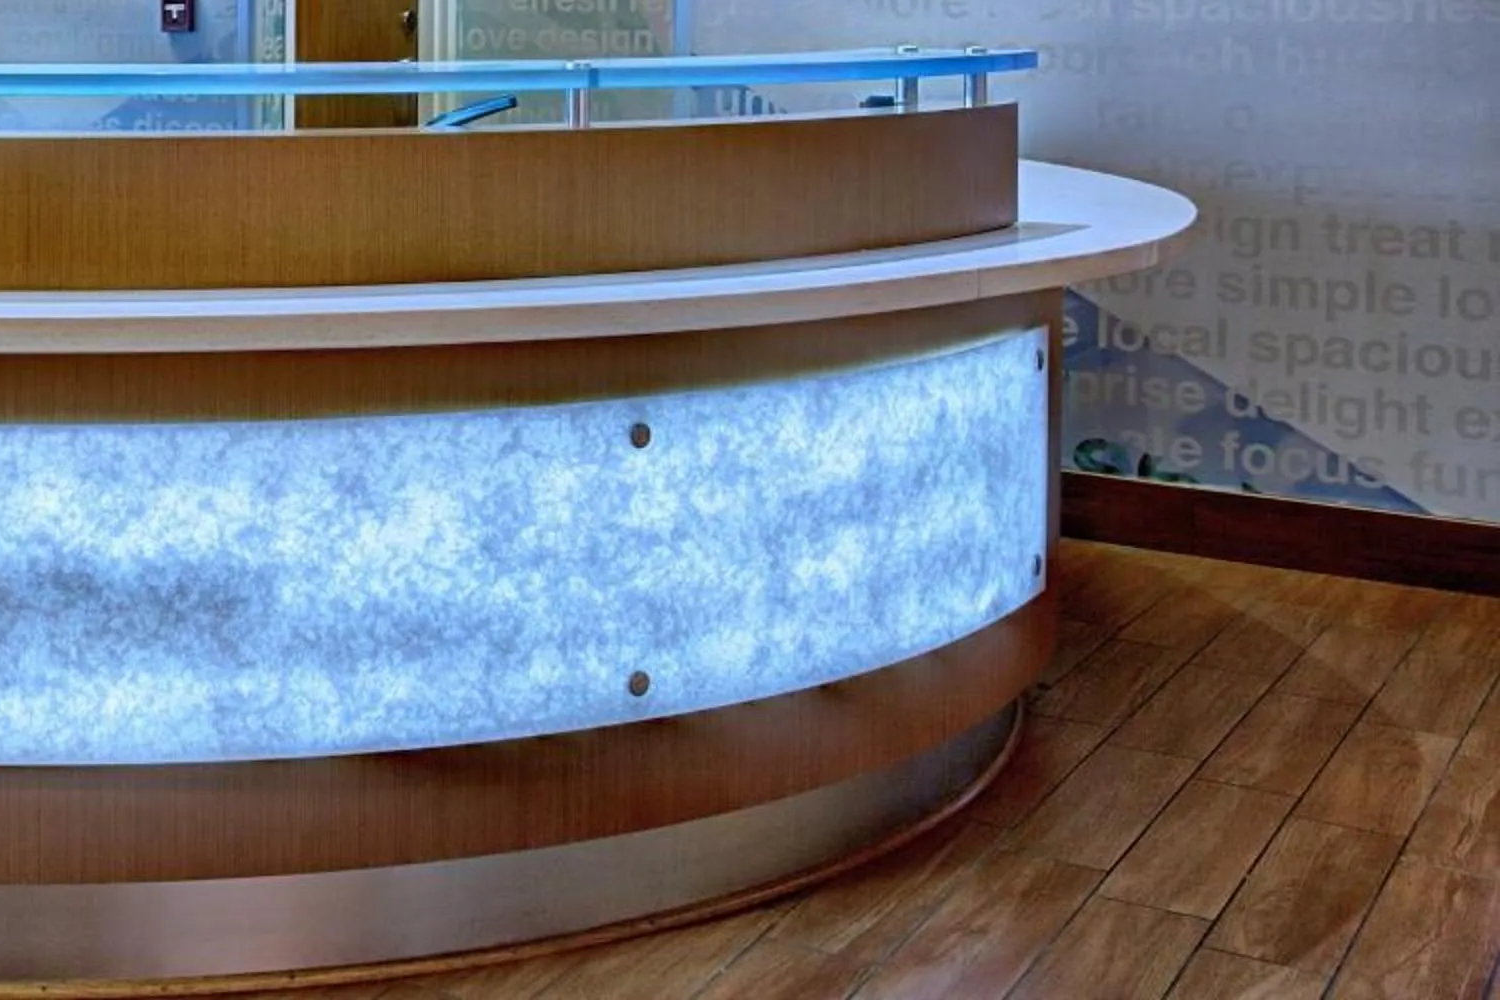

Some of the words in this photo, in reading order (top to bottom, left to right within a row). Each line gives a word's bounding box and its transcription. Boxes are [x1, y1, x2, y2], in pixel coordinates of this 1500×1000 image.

[1322, 213, 1468, 262] treat
[1217, 264, 1417, 321] simple
[1099, 311, 1228, 359] local
[1225, 377, 1433, 441] delight
[1220, 430, 1388, 485] focus
[1409, 449, 1500, 500] fun
